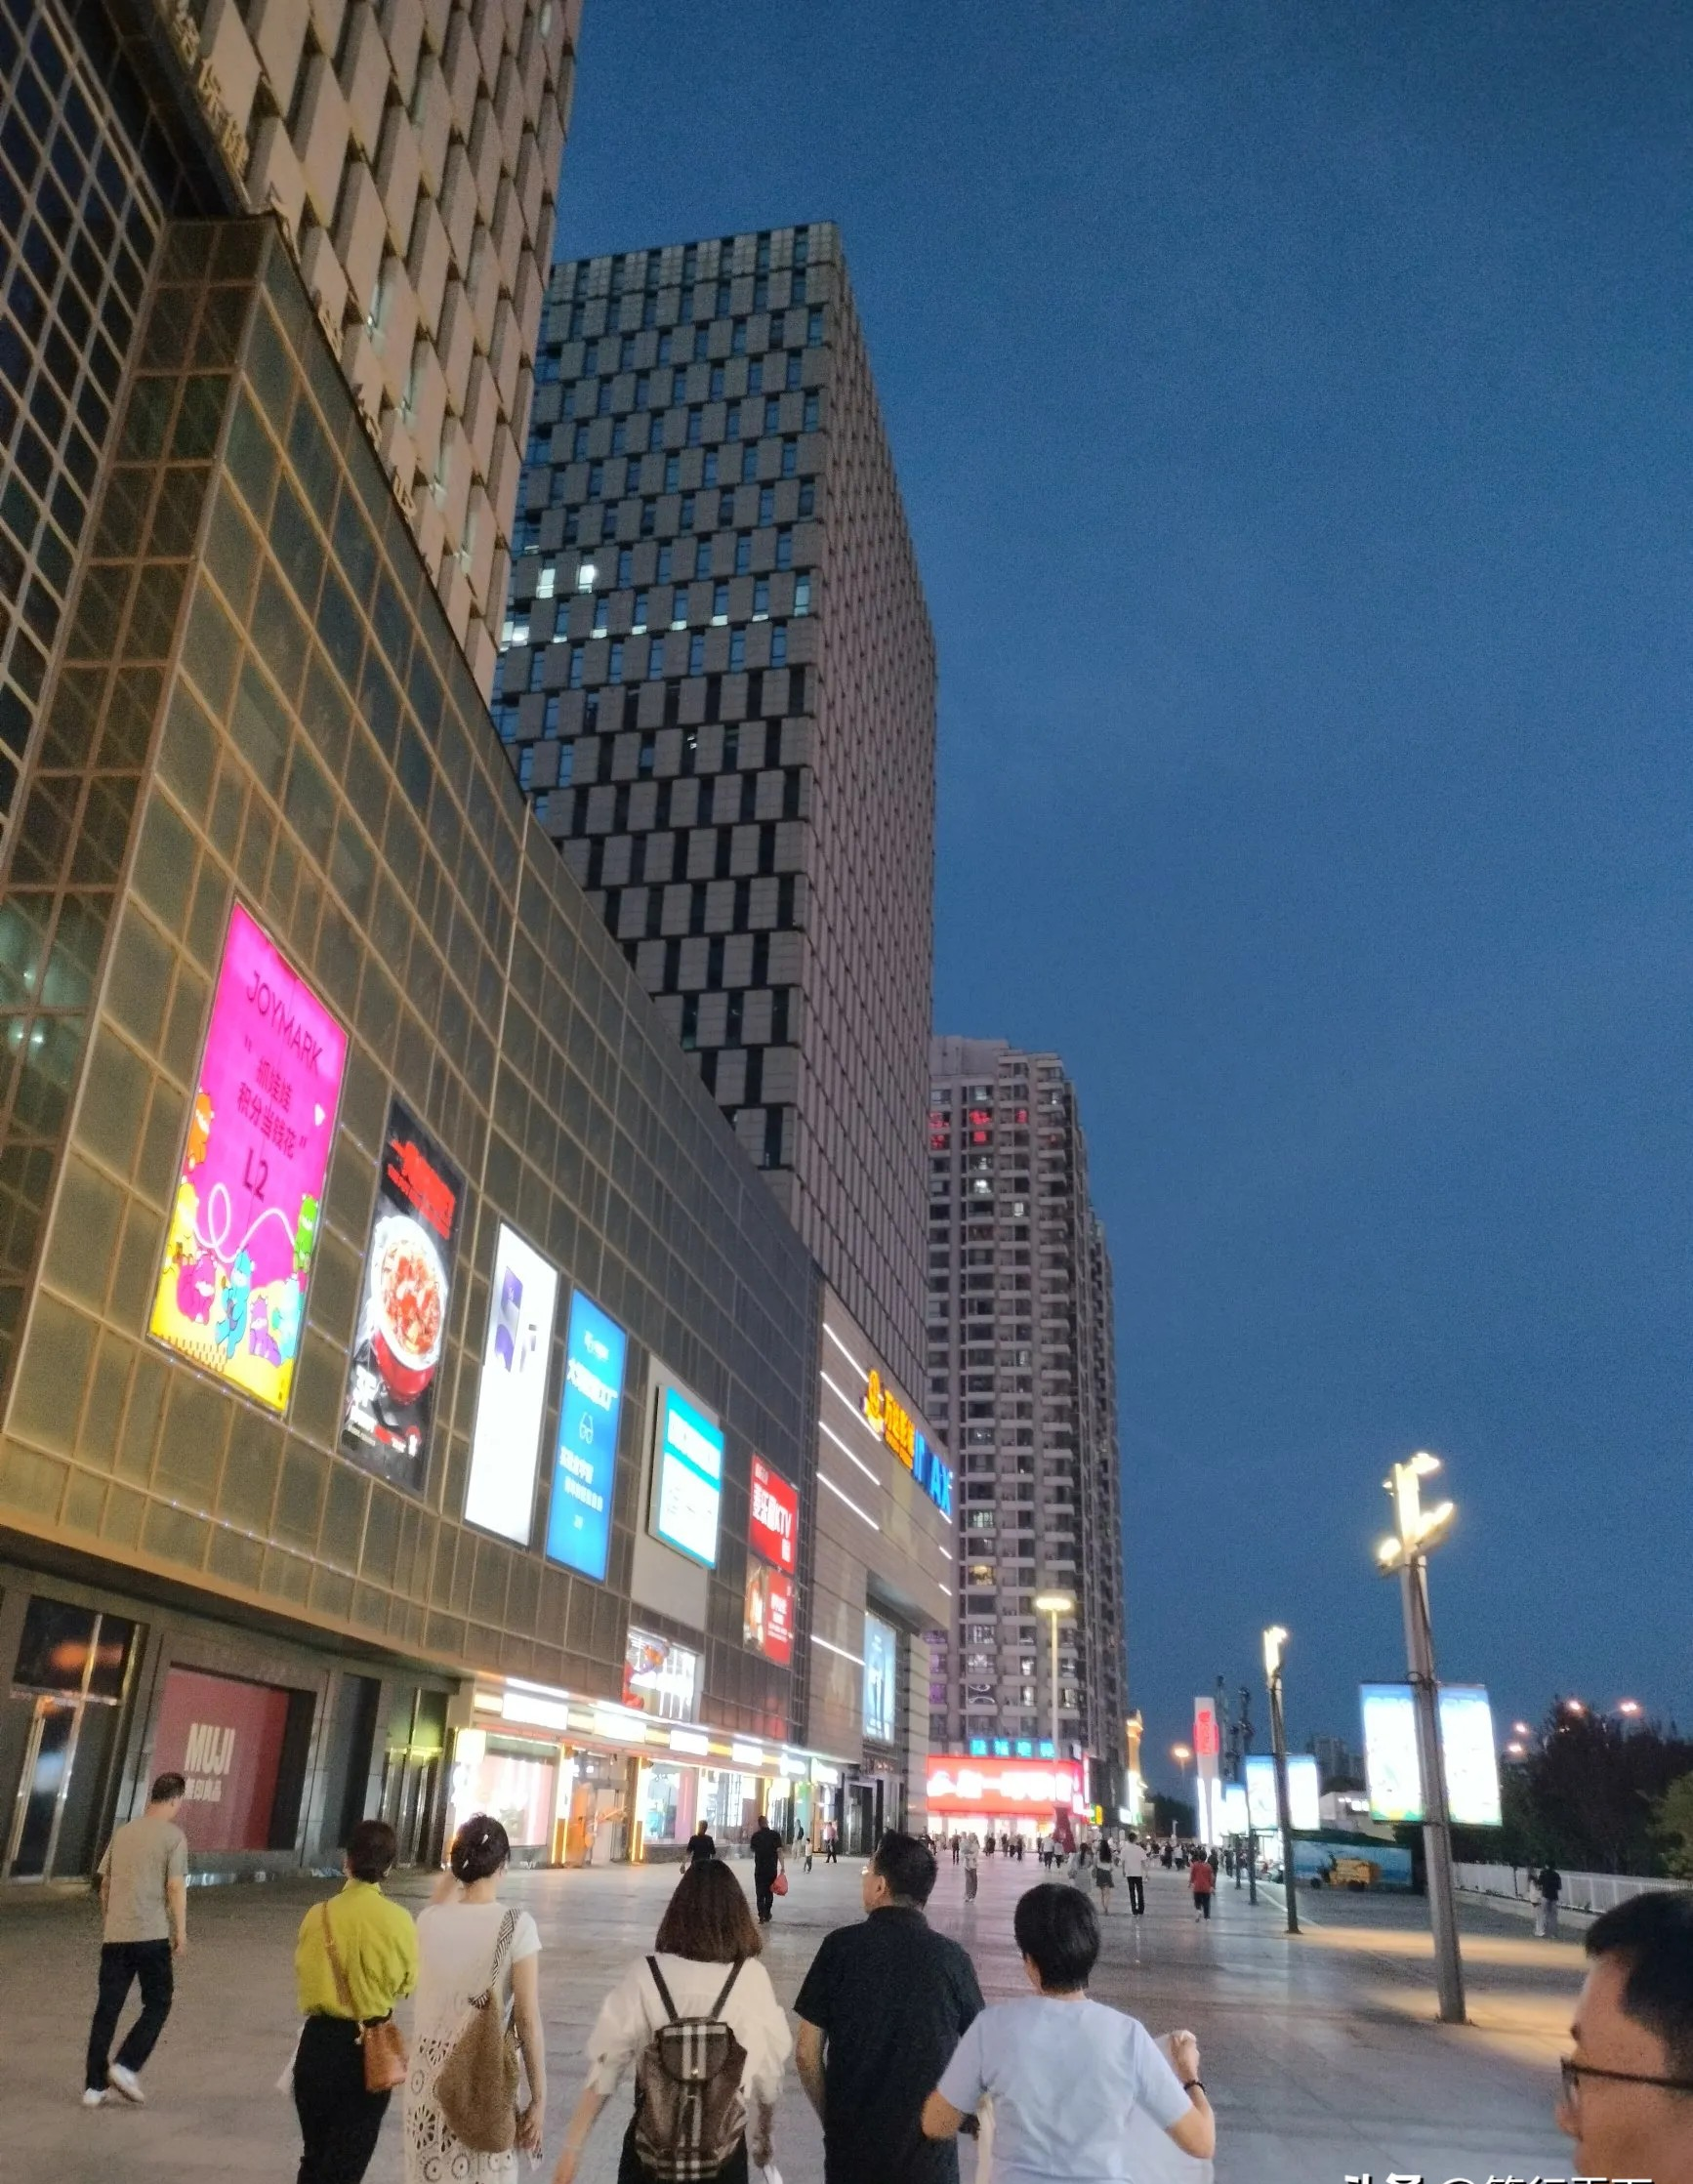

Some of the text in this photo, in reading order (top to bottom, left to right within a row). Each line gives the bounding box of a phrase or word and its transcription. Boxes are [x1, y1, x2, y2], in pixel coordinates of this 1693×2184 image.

[247, 970, 323, 1075] JOYMARK
[243, 1148, 268, 1203] L2
[184, 1723, 235, 1775] MUJI
